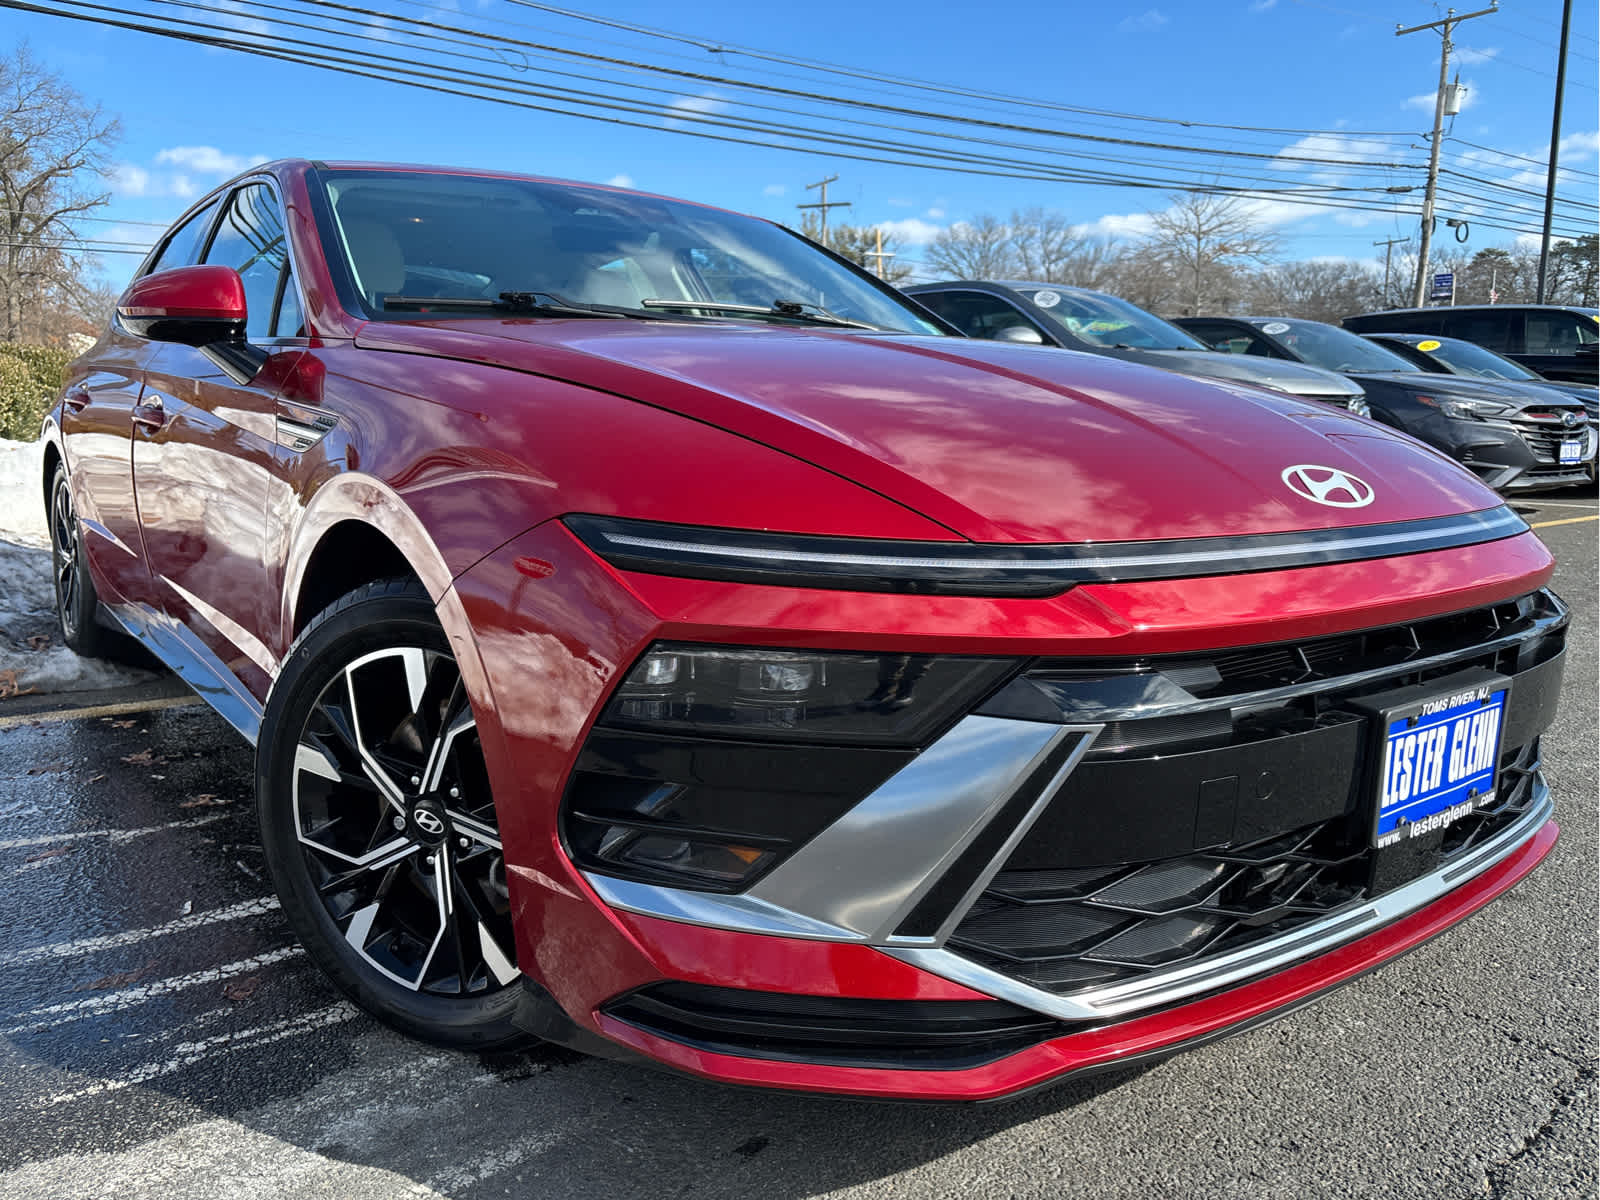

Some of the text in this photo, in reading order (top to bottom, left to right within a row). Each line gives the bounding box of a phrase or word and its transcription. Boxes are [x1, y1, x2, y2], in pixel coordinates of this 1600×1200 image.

[1422, 703, 1448, 716] TOMS
[1381, 707, 1500, 808] LESTER GLENN
[1409, 802, 1473, 838] lesterglenn
